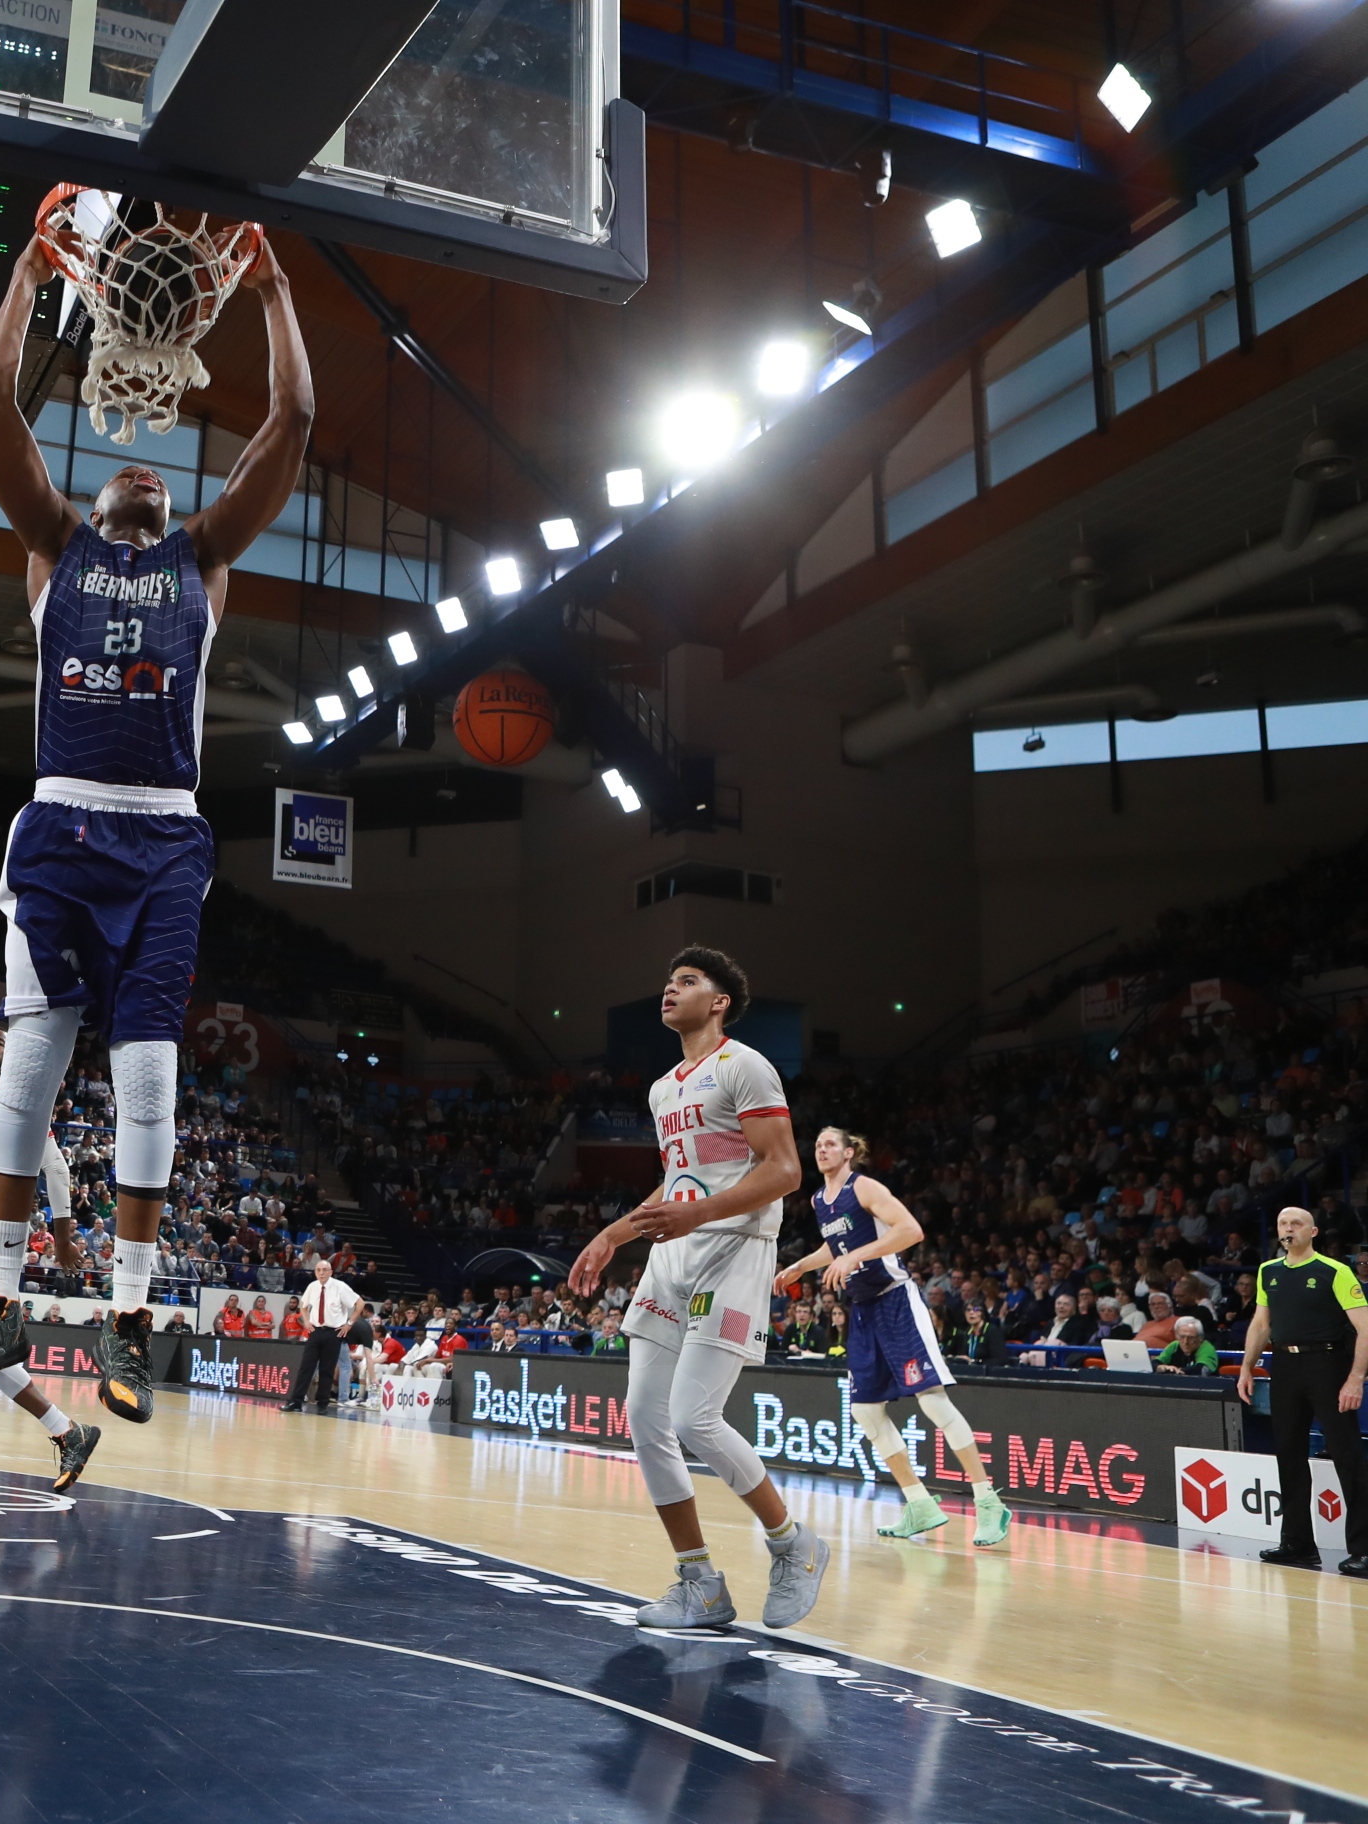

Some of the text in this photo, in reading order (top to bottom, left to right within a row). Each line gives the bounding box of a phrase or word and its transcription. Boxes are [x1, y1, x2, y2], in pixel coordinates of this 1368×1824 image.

[66, 308, 89, 348] Bodet
[104, 618, 143, 656] 23
[479, 686, 501, 703] La
[293, 816, 344, 845] bleu
[315, 814, 344, 826] france
[317, 842, 344, 854] béarn
[276, 869, 349, 884] www.bleubearn.fr
[197, 1017, 260, 1072] 23
[635, 1297, 679, 1324] Nicoll
[28, 1344, 64, 1372] LE
[190, 1340, 290, 1395] Basket LE MAG
[397, 1388, 414, 1411] dpd
[433, 1394, 452, 1408] dpd
[472, 1358, 567, 1437] Basket
[570, 1394, 601, 1435] LE
[935, 1428, 992, 1484] LE
[1008, 1435, 1146, 1506] MAG
[282, 1516, 479, 1567] CASINO
[446, 1569, 590, 1597] DE
[837, 1679, 1100, 1754] GROUPE
